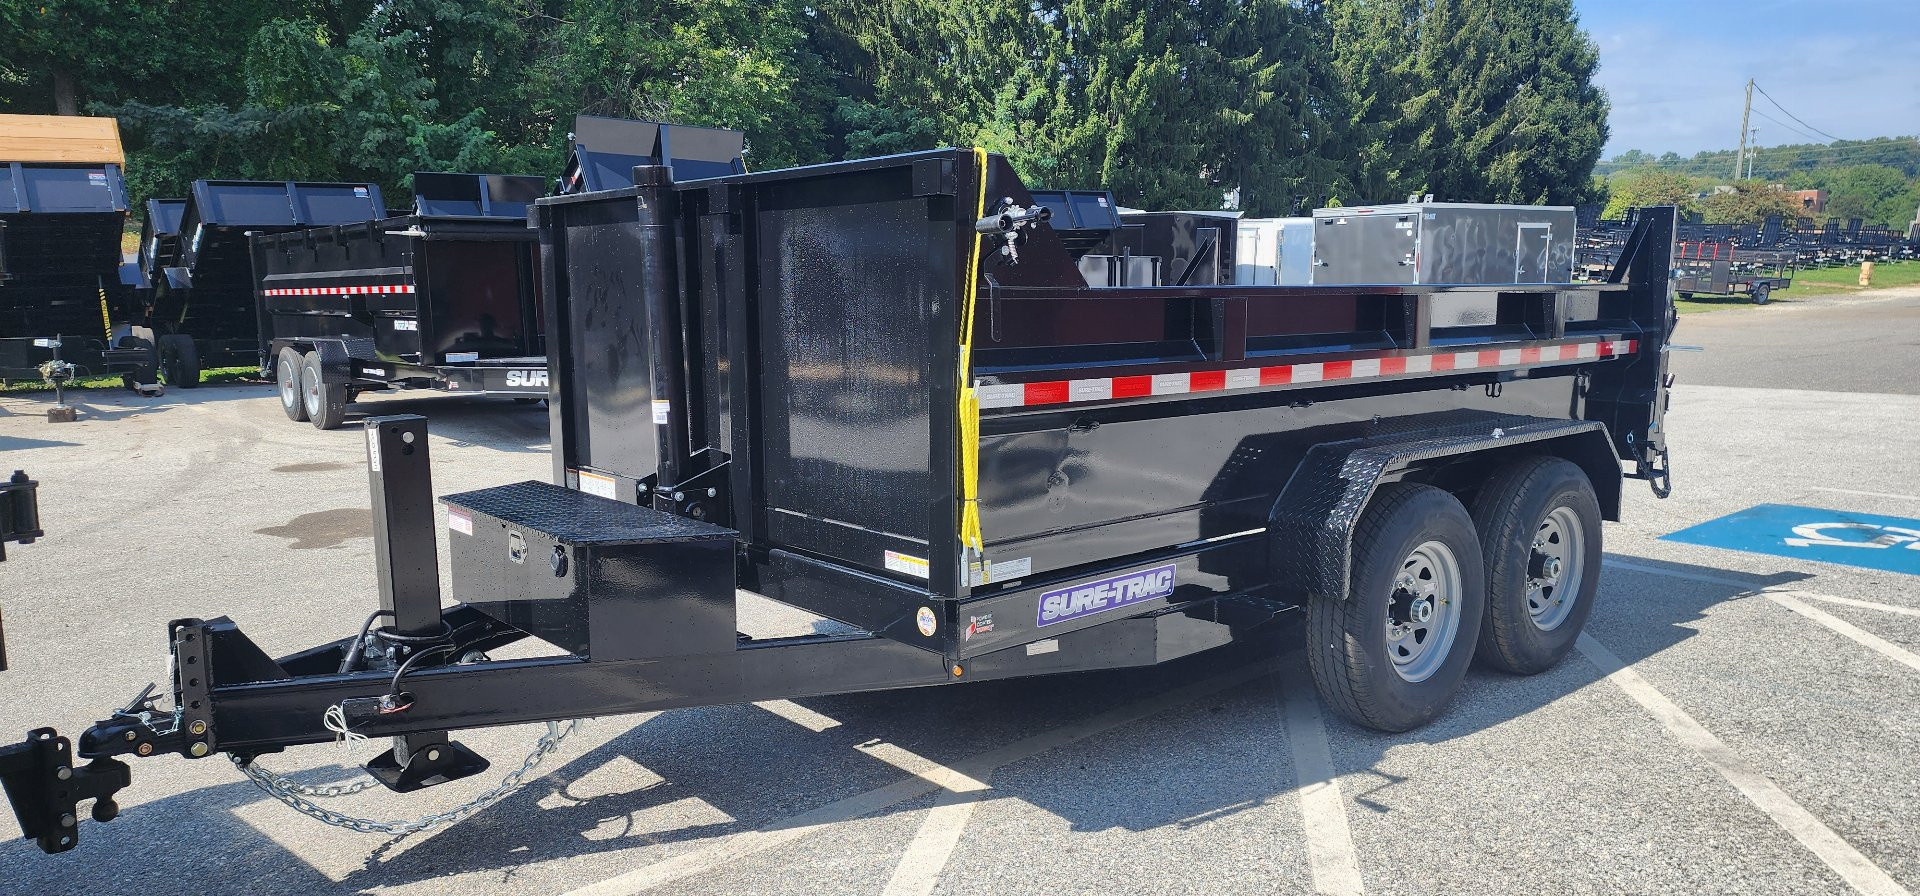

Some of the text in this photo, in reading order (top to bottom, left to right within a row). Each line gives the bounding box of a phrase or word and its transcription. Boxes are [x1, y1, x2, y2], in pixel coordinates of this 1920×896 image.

[1078, 386, 1104, 394] SURE-TRAC
[986, 392, 1015, 400] SURE-TRAC
[1042, 570, 1172, 620] SURE-TRAC
